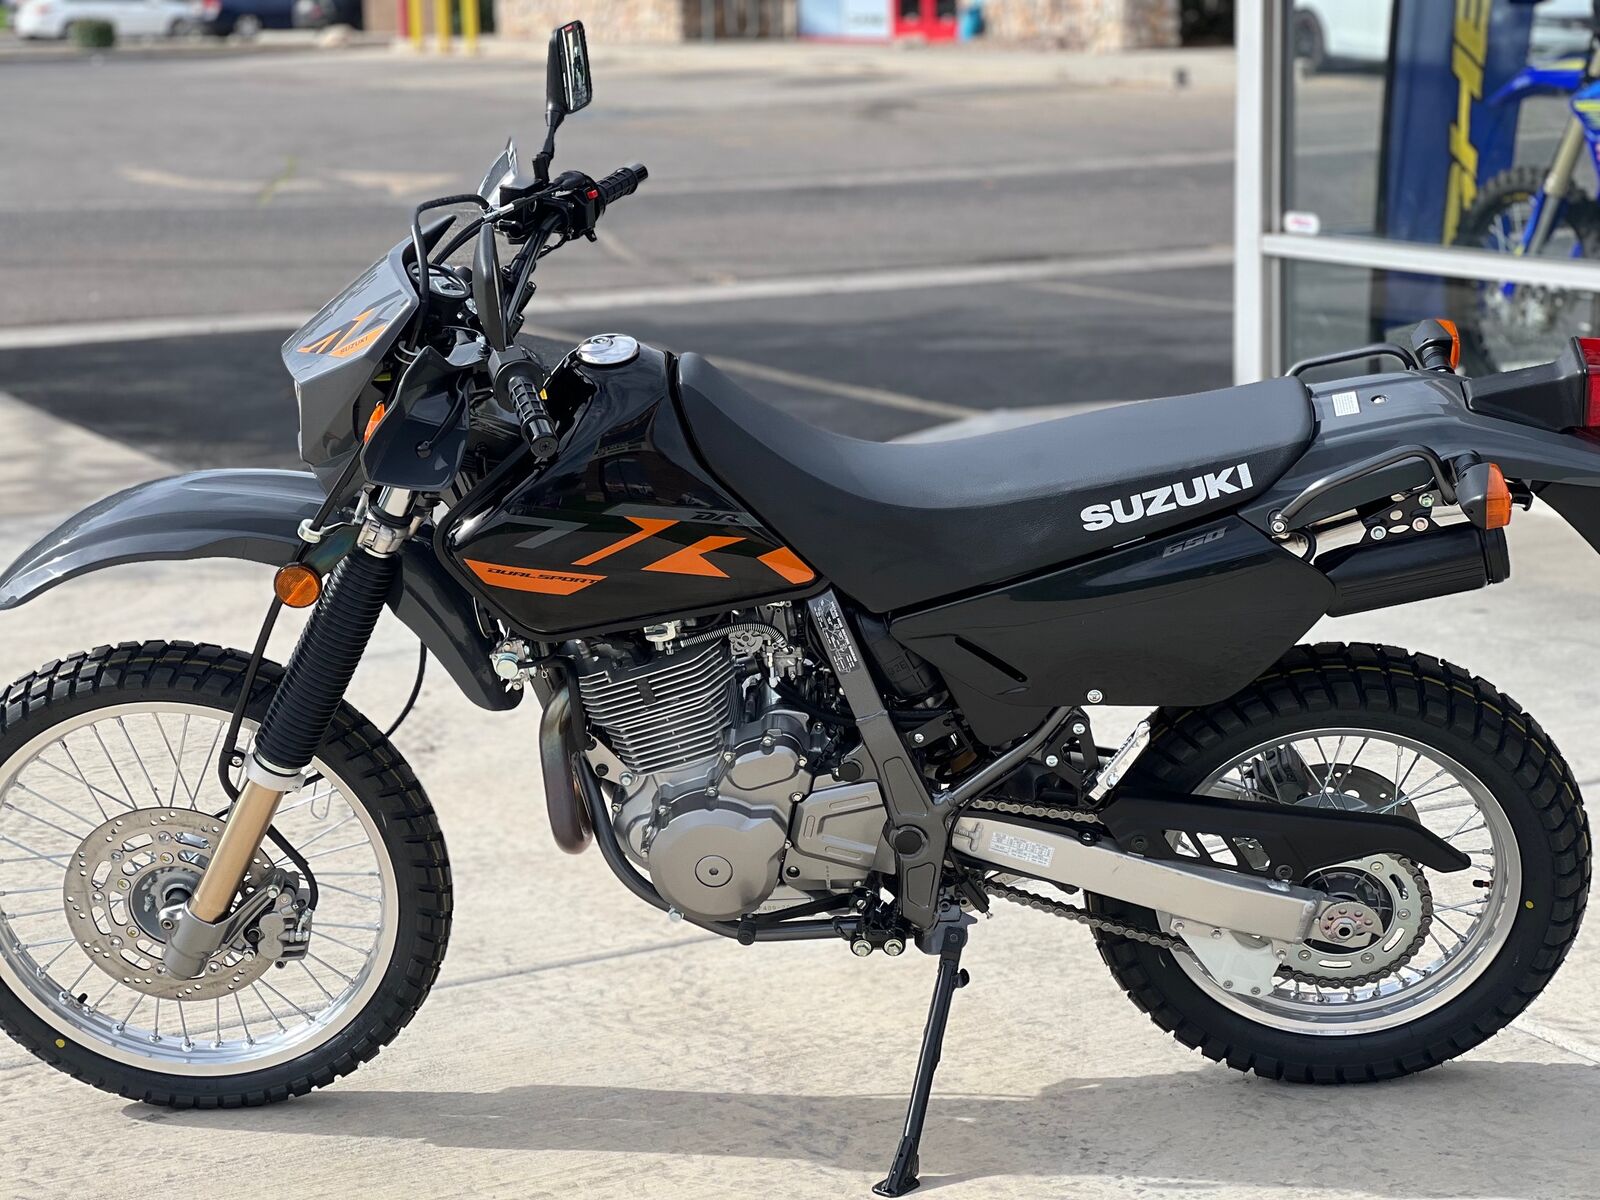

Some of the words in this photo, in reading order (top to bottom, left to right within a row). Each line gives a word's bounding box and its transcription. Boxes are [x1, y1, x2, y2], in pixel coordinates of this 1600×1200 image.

[1080, 463, 1254, 532] SUZUKI
[690, 511, 740, 523] DR
[1163, 526, 1228, 558] 650
